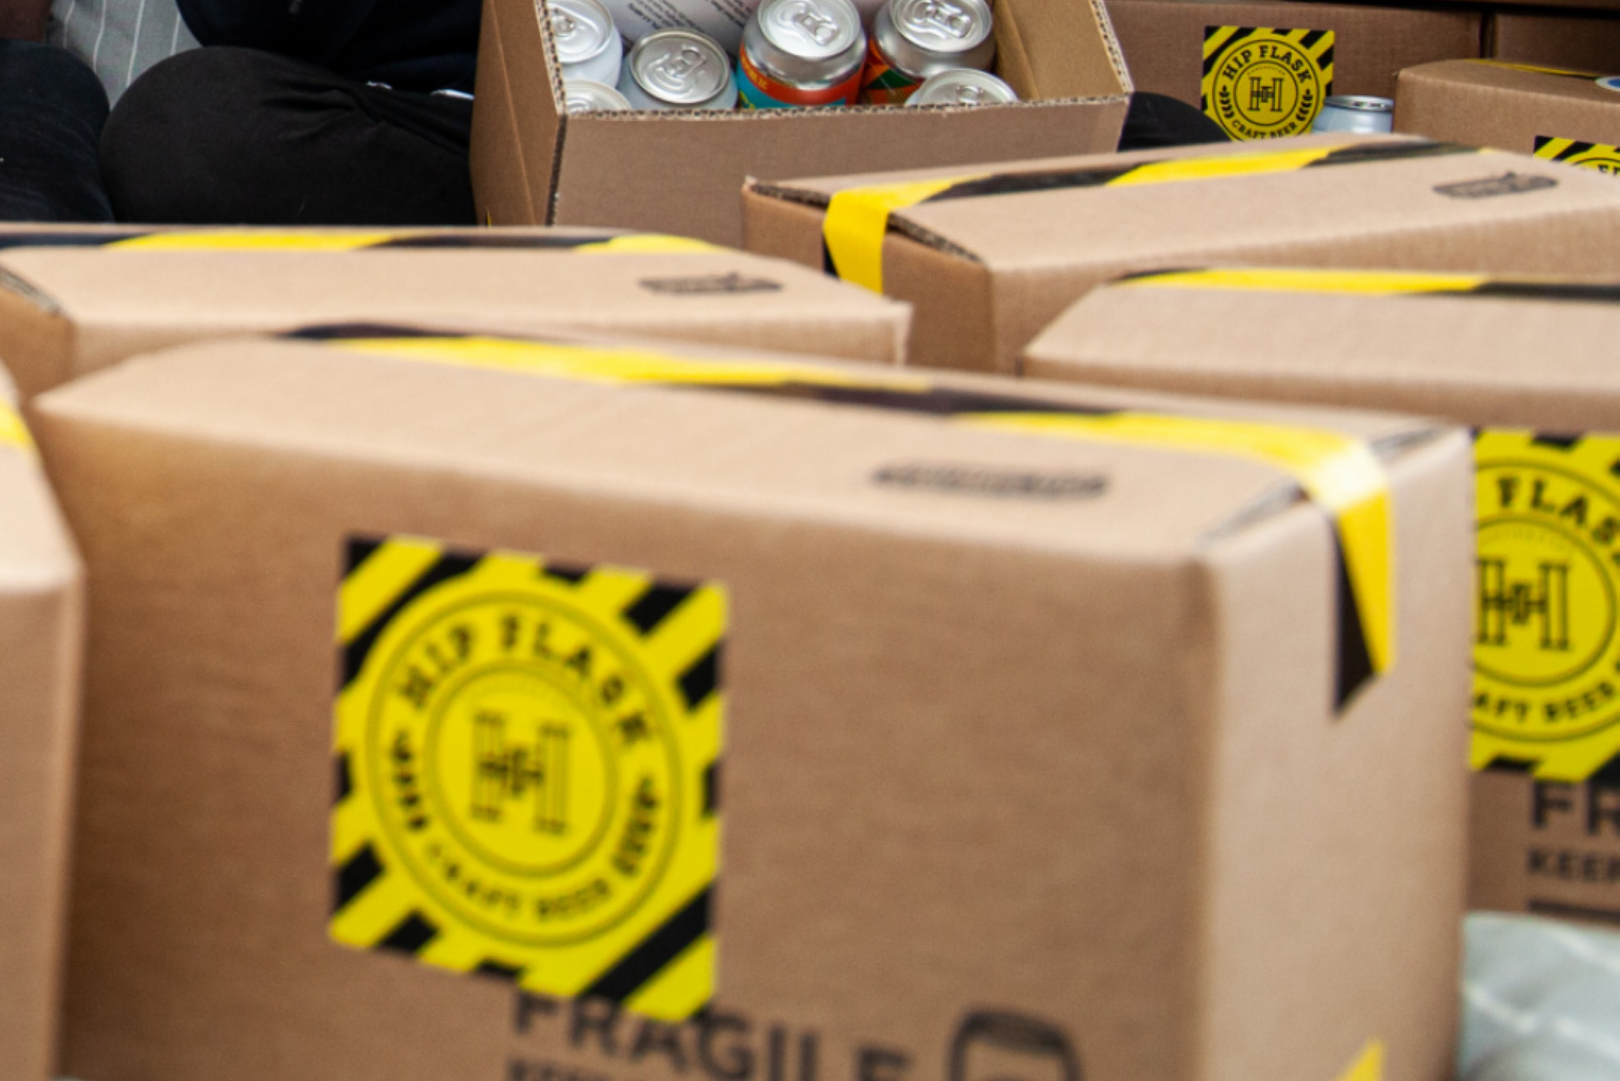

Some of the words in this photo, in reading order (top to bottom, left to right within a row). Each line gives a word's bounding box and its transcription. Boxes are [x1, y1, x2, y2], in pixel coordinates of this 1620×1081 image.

[1222, 49, 1252, 81] HIP
[1259, 45, 1312, 83] FLASK
[1231, 120, 1266, 139] CRAFT
[1497, 476, 1620, 566] FLAS
[392, 618, 478, 710] HIP
[500, 610, 655, 750] FLASK
[1474, 693, 1530, 722] AFT
[1543, 681, 1617, 724] BEER
